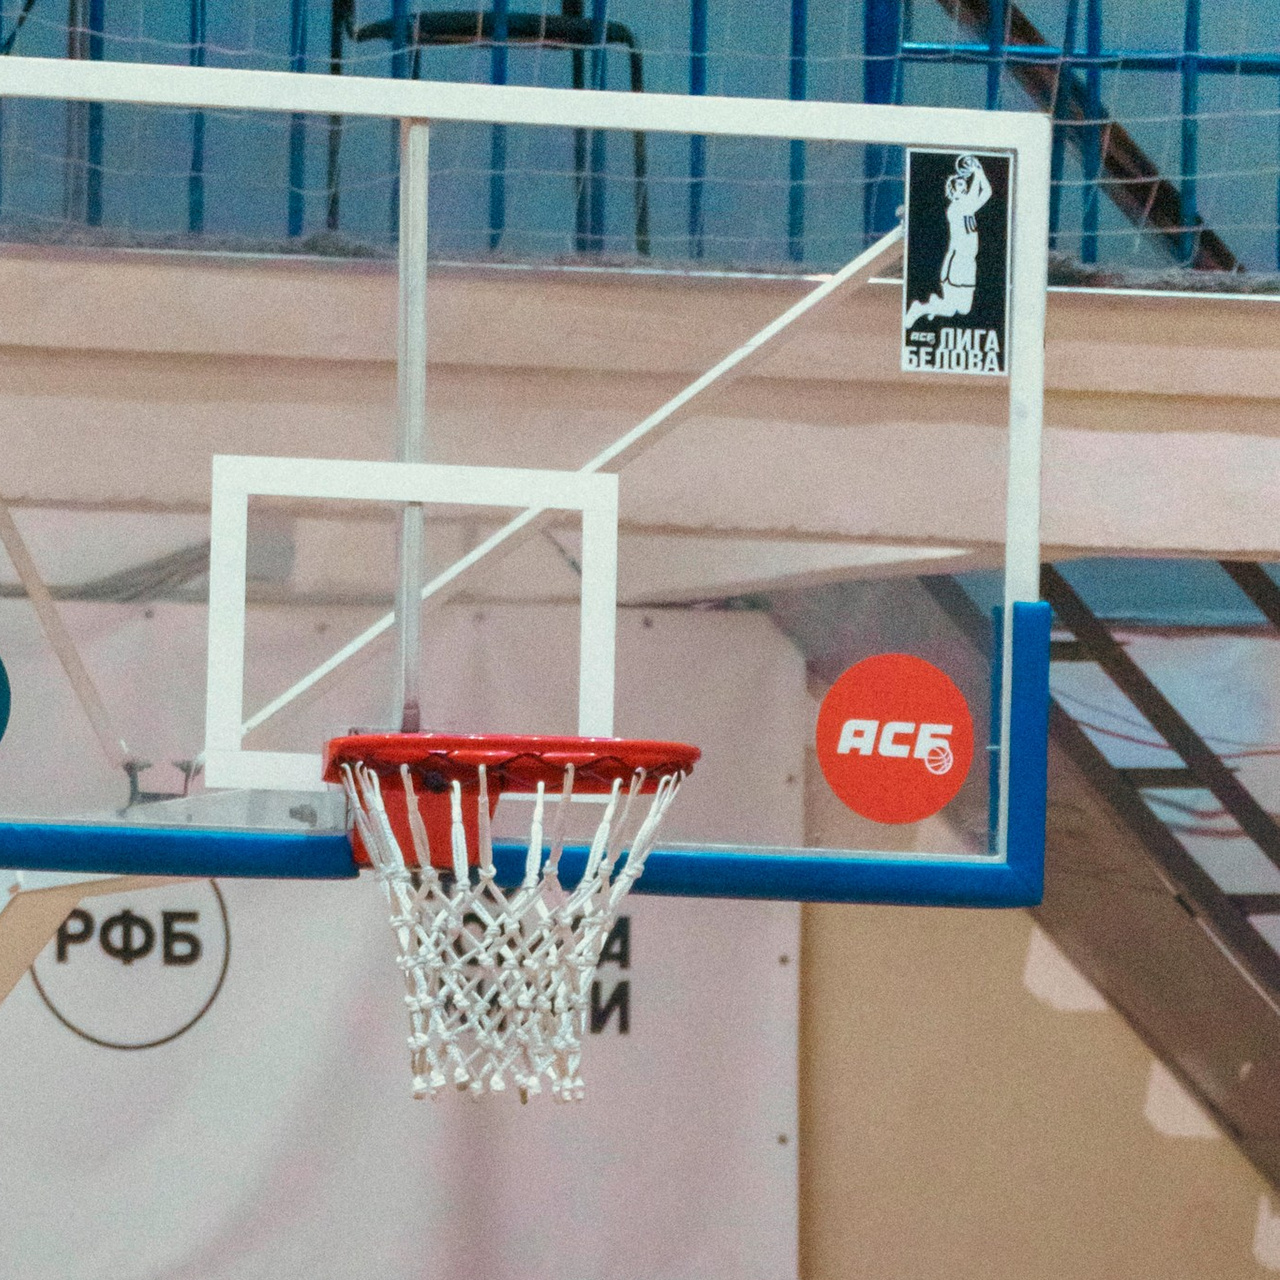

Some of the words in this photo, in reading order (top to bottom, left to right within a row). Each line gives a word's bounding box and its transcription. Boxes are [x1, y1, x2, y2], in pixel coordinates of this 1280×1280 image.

[939, 327, 1000, 353] ЛИГА
[905, 346, 1000, 373] БЕЛОВА
[56, 908, 203, 967] РФБ
